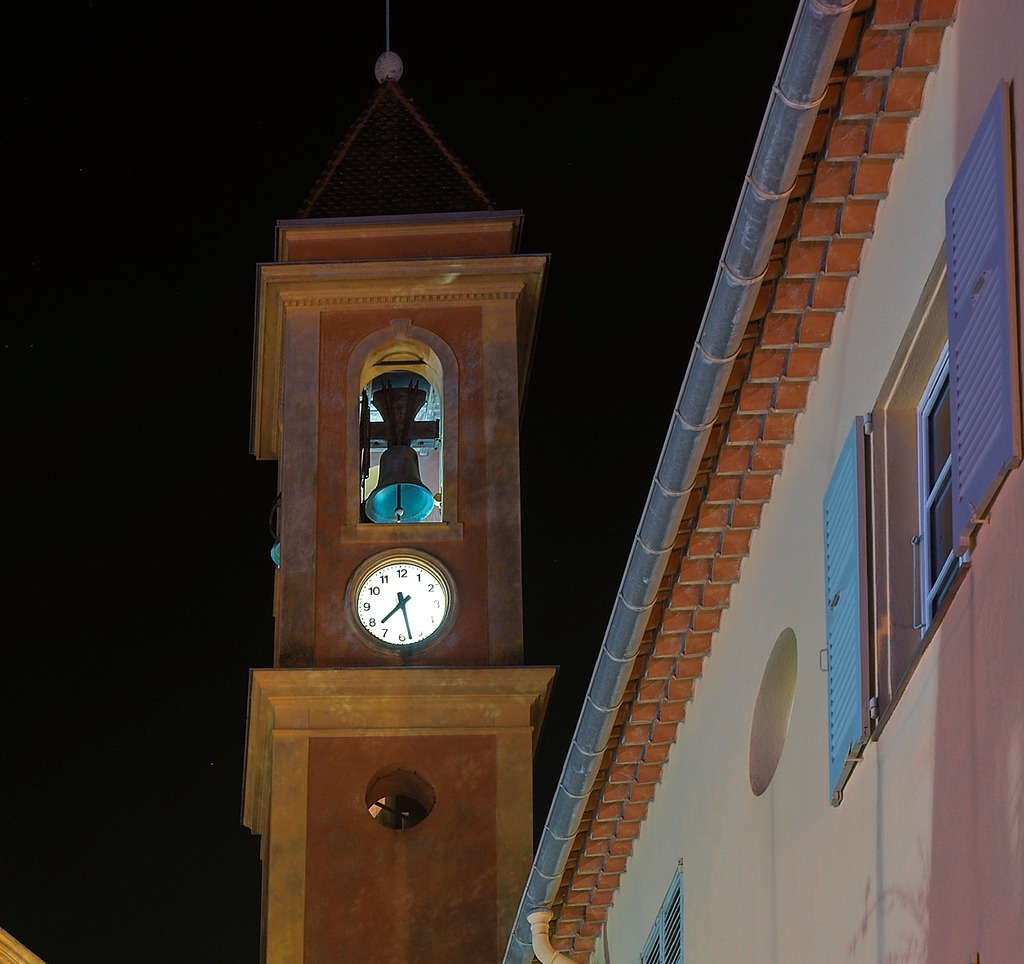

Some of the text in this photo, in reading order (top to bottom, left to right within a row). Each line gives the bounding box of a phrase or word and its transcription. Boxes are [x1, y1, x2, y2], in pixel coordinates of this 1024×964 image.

[396, 568, 408, 578] 12
[416, 573, 421, 582] 1
[380, 575, 389, 584] 11
[368, 586, 380, 595] 10
[427, 583, 434, 592] 2
[363, 602, 371, 611] 9
[368, 618, 376, 627] 8
[382, 628, 388, 638] 7
[398, 633, 406, 642] 6
